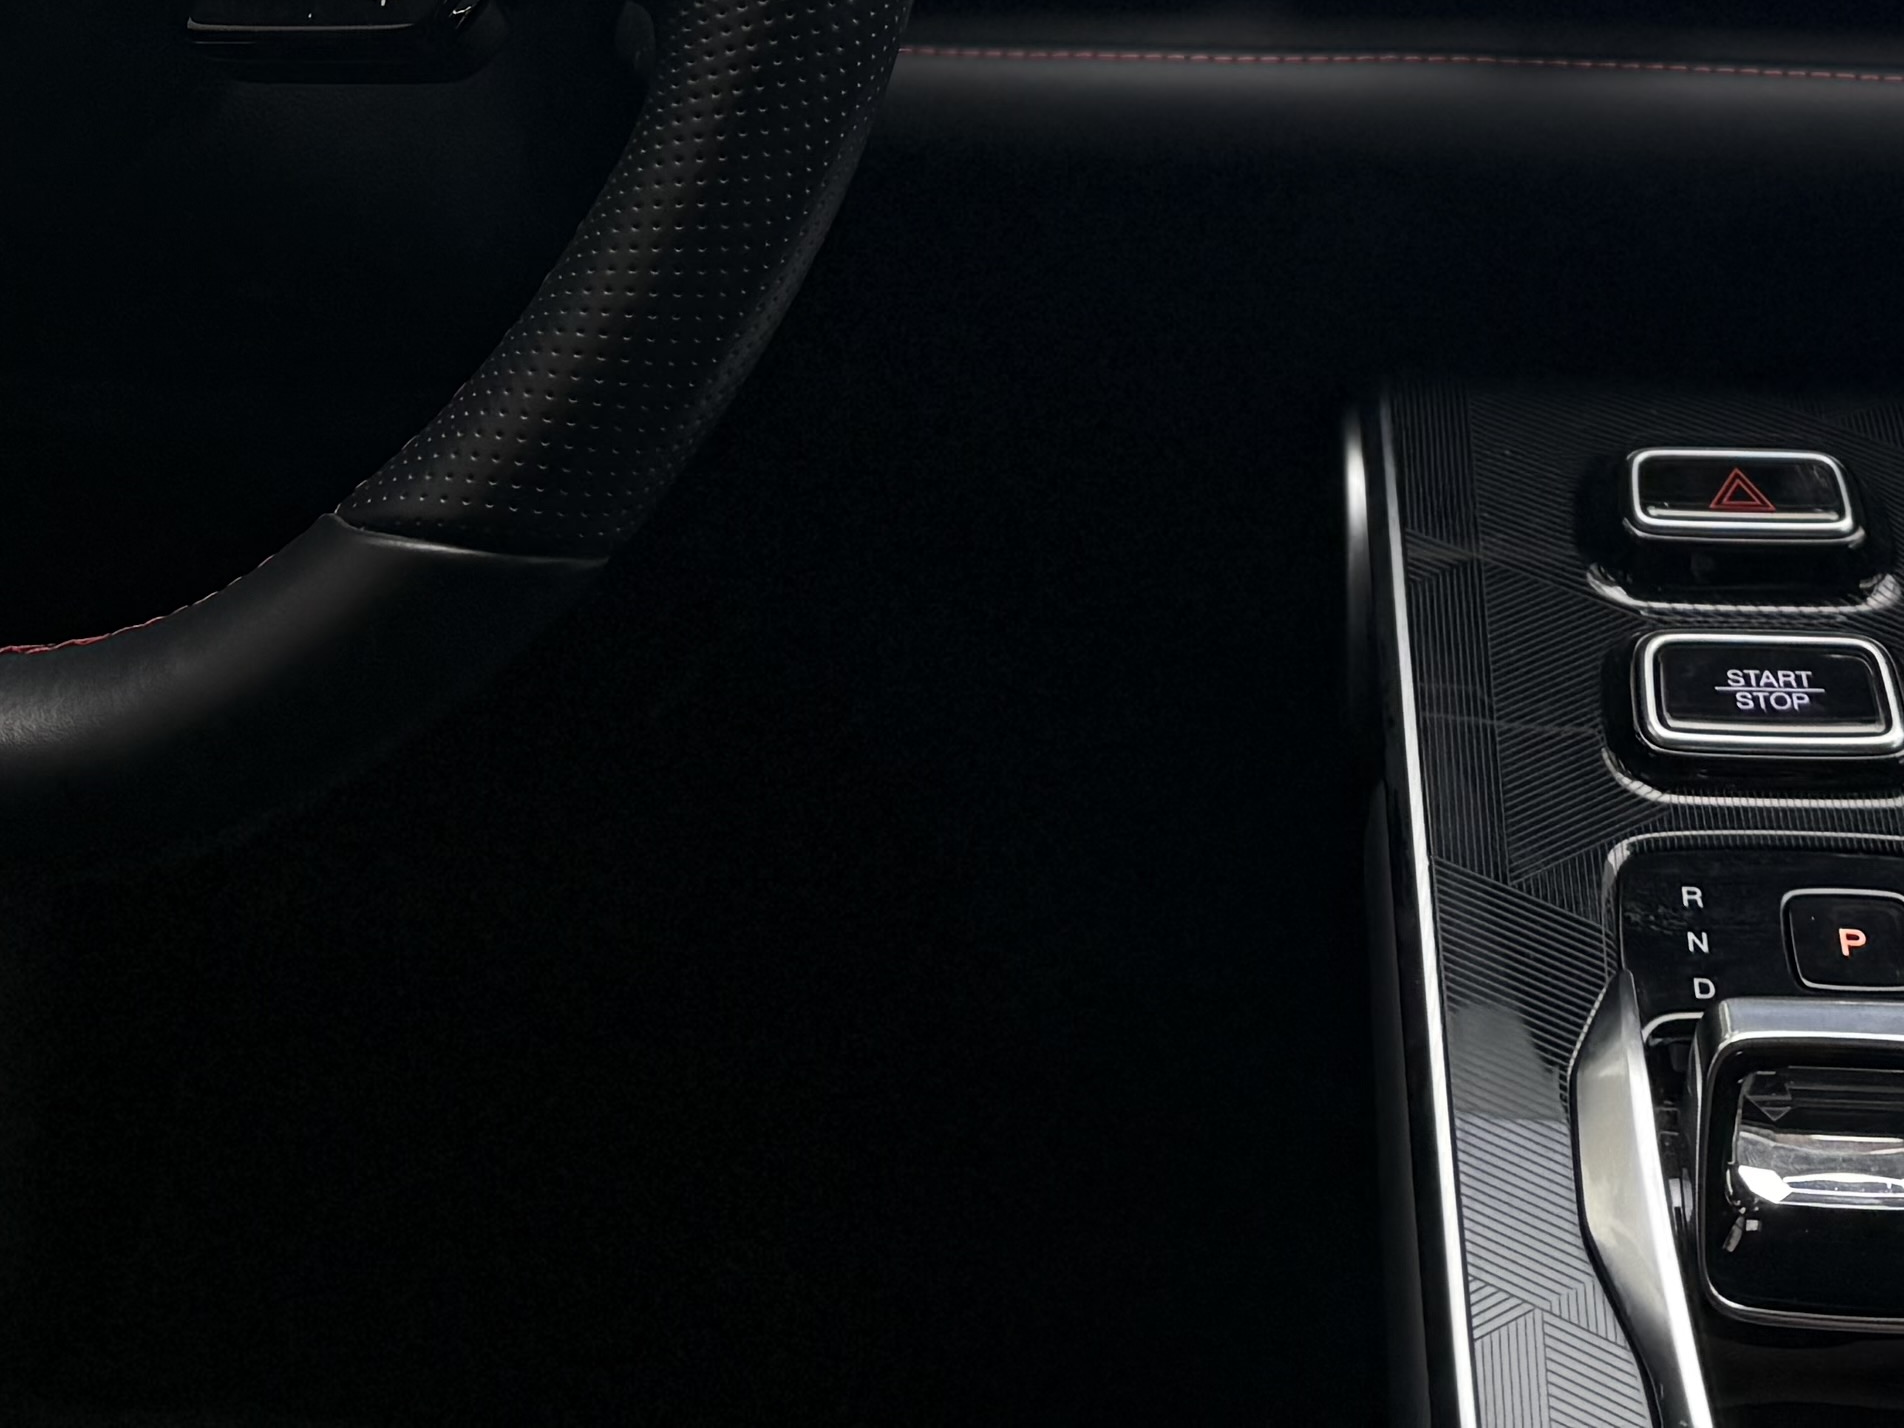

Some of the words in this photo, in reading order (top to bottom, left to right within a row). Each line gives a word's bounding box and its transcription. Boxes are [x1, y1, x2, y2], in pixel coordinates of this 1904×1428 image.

[1725, 668, 1813, 689] START
[1734, 690, 1811, 712] STOP
[1681, 885, 1704, 908] R
[1686, 930, 1709, 954] N
[1838, 927, 1868, 956] P
[1692, 976, 1716, 1000] D
